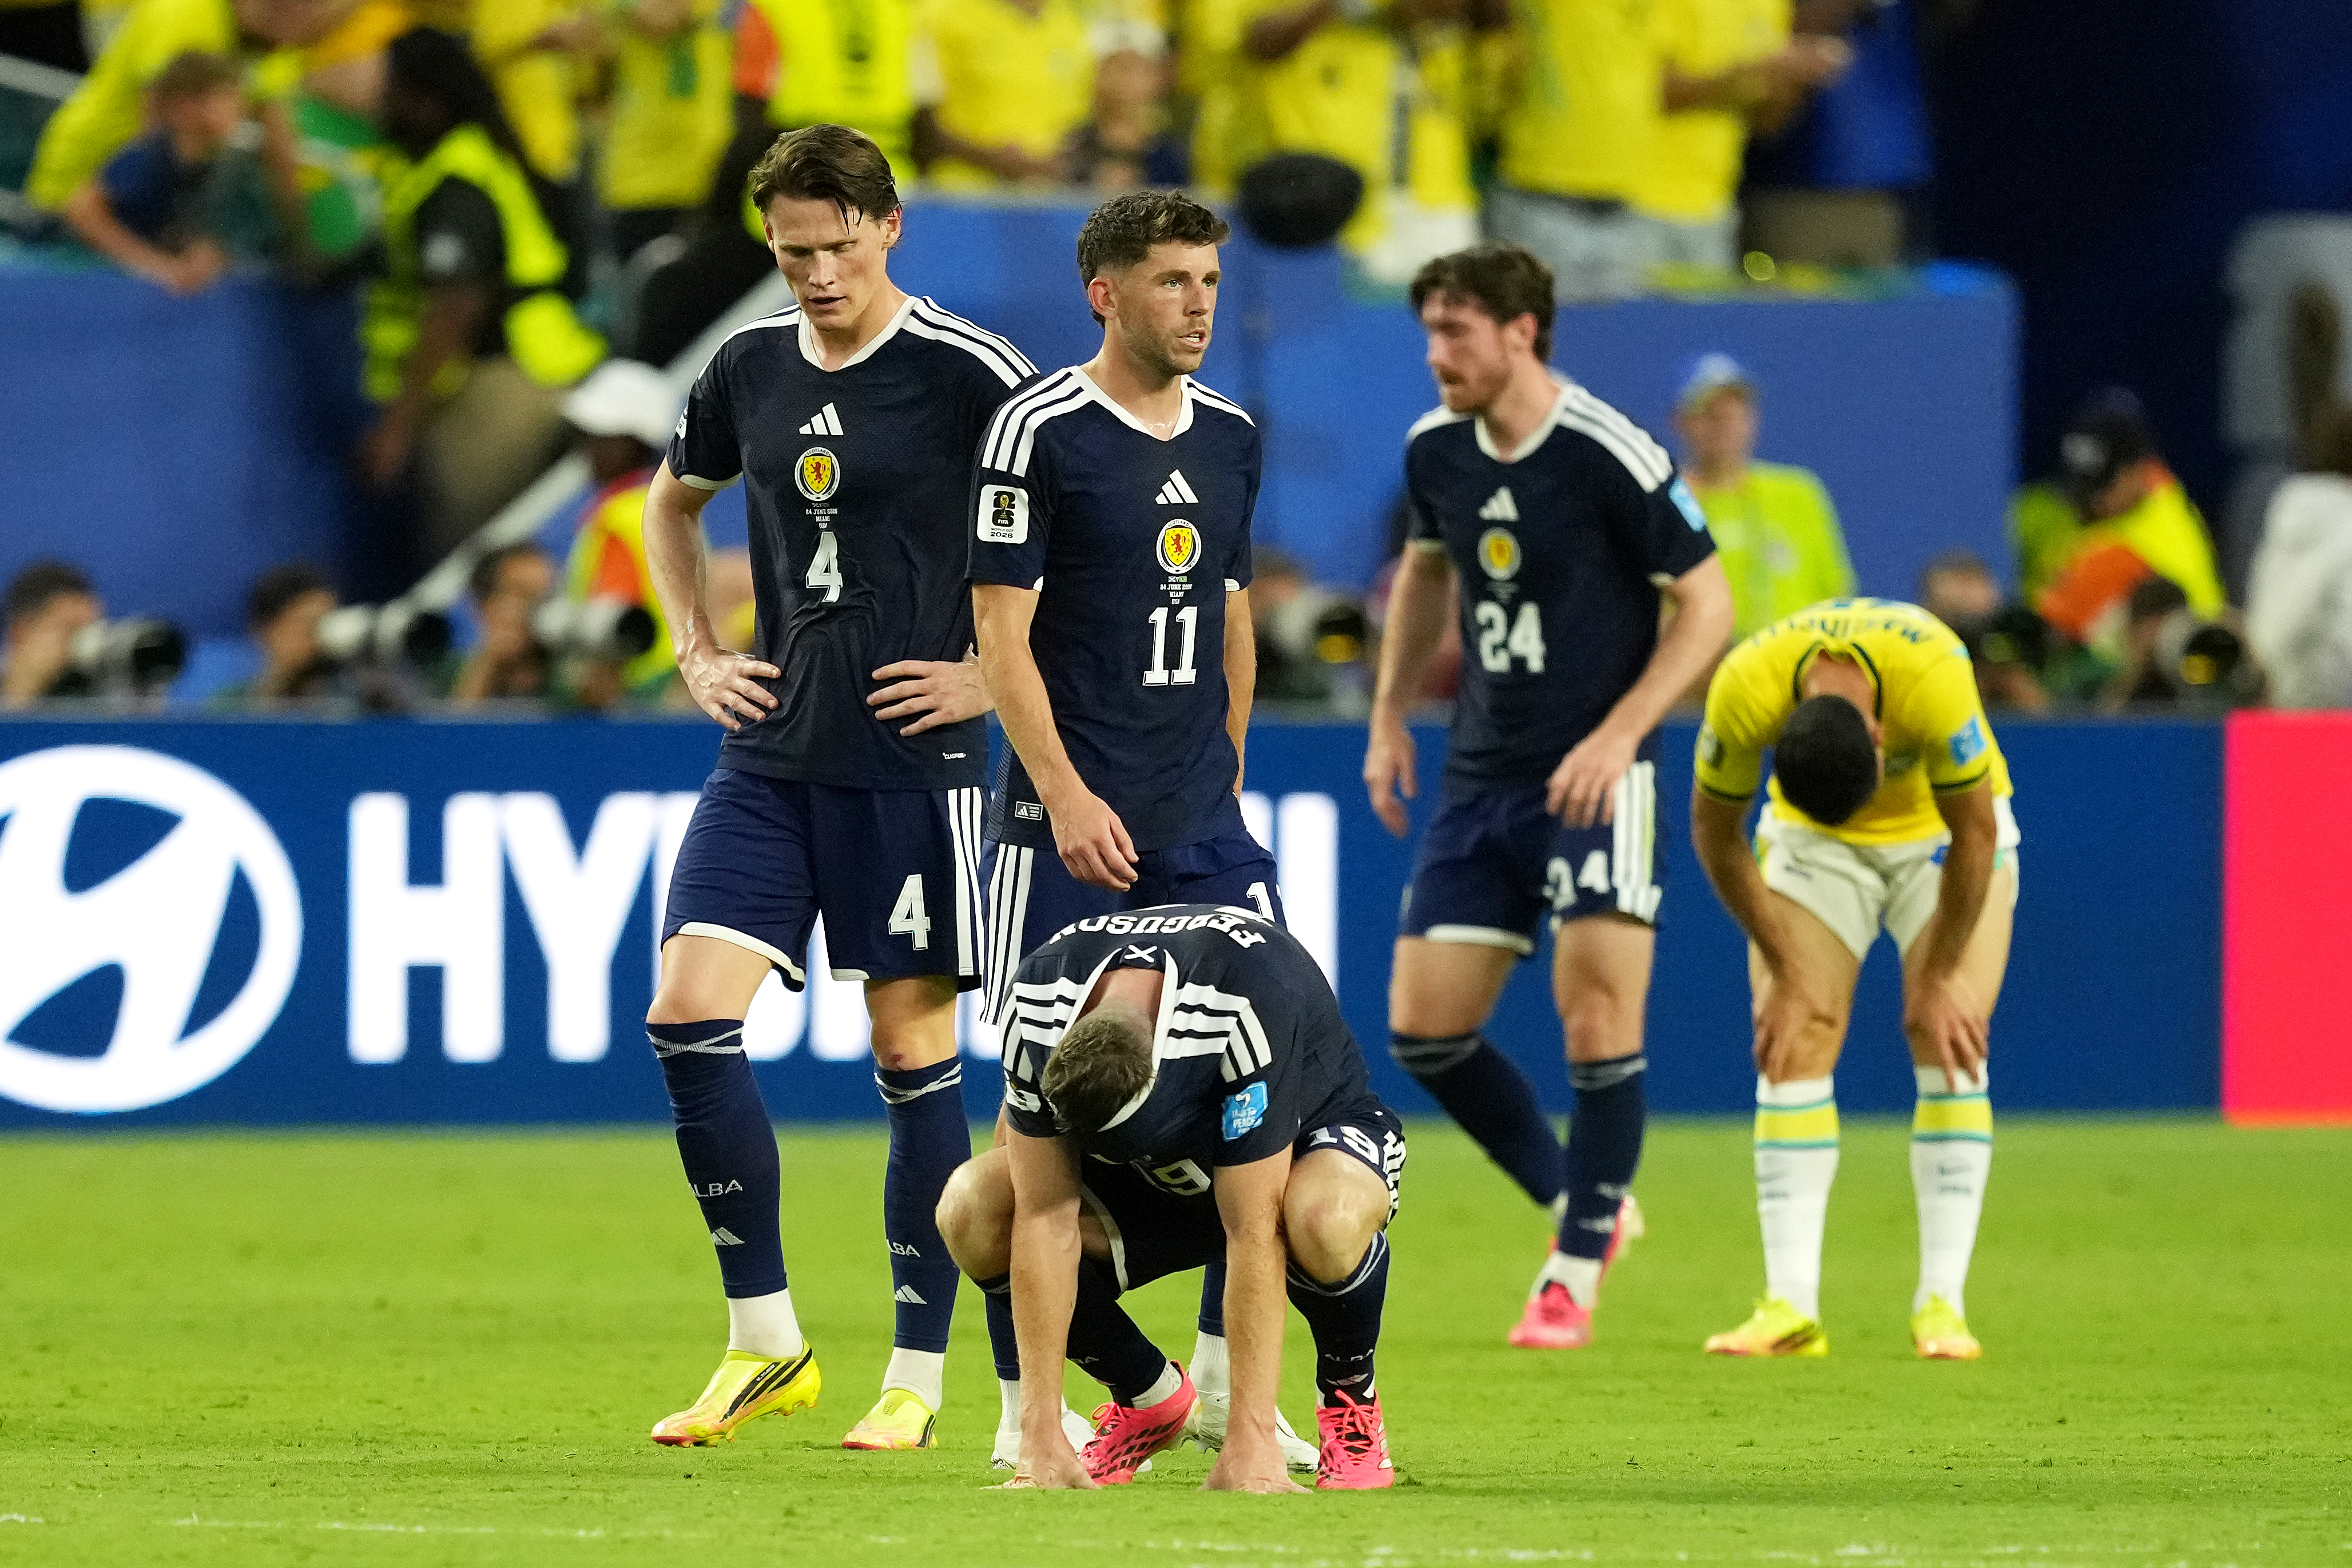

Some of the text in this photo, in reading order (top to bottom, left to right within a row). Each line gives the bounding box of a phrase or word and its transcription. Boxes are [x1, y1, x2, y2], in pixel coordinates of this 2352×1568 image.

[806, 531, 843, 603] 4
[1142, 606, 1198, 686] 11
[1474, 599, 1547, 674] 24
[888, 873, 931, 951] 4
